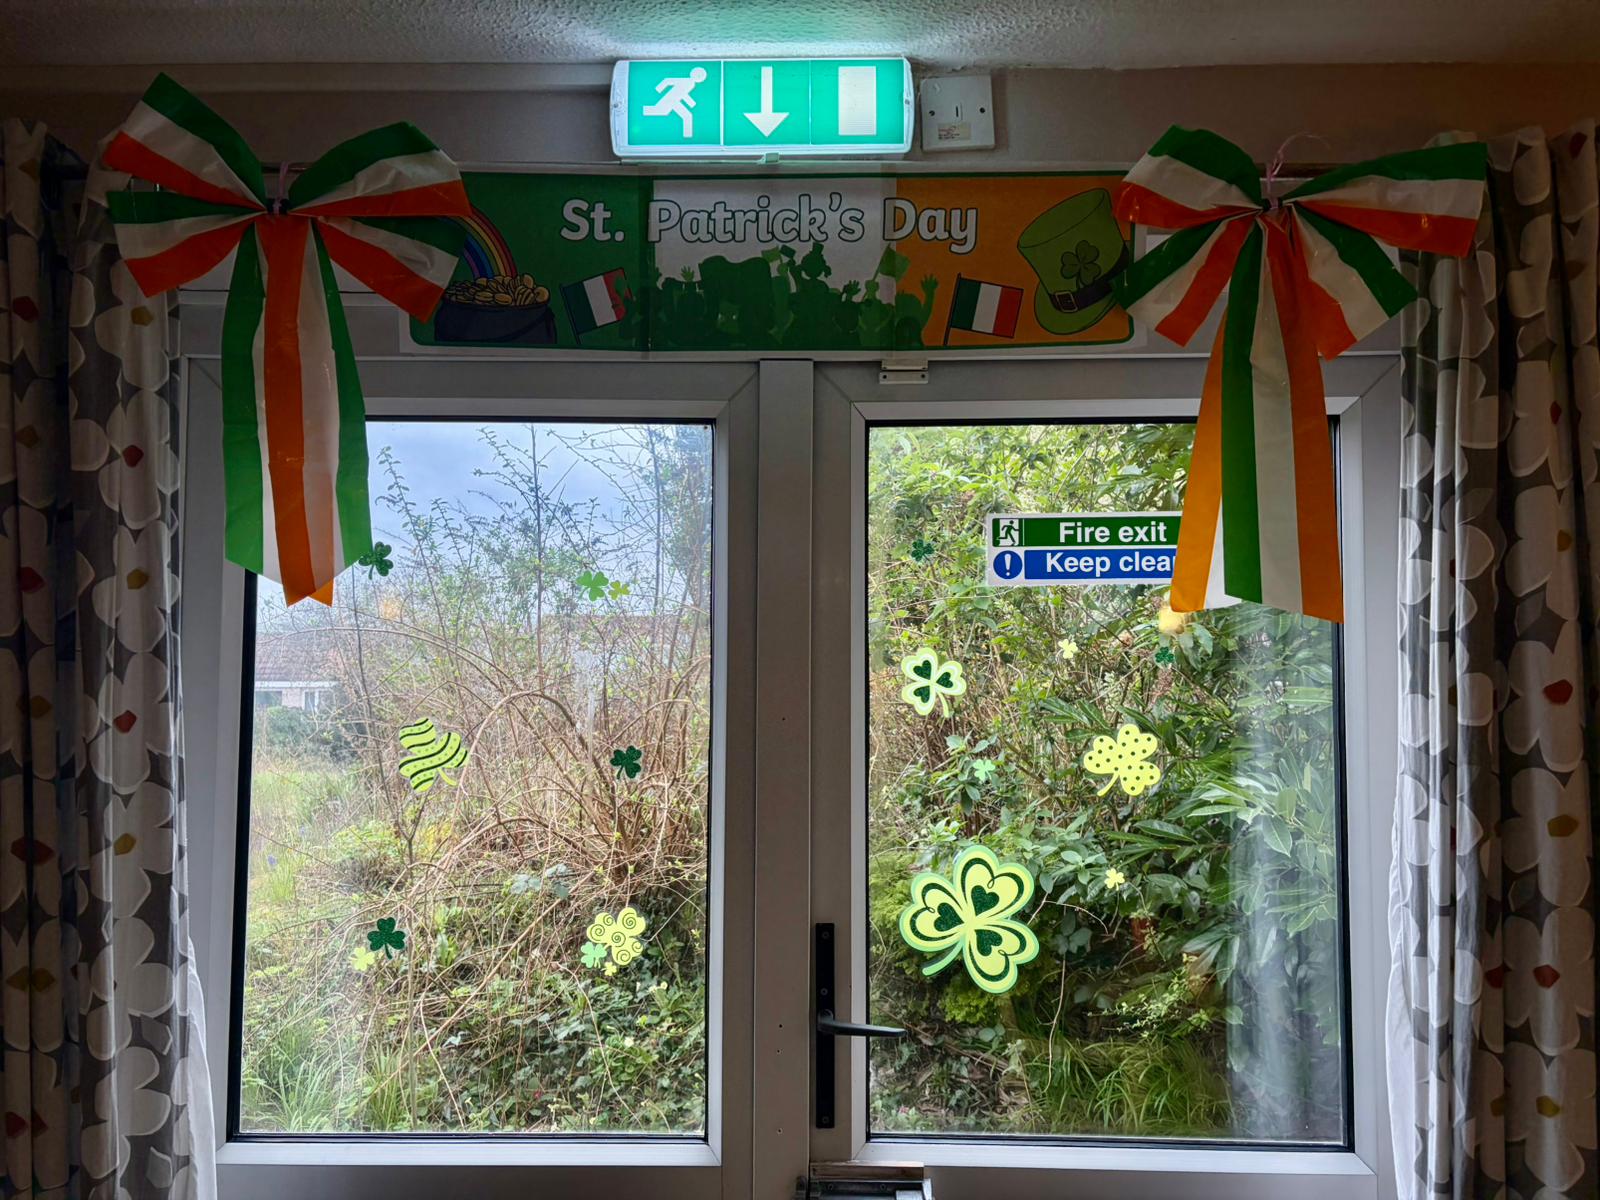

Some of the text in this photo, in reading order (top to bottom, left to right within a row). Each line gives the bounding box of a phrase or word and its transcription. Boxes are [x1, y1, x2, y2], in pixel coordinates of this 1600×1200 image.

[560, 192, 979, 255] St. Patrick's Day
[1059, 521, 1168, 543] Fire exit
[1046, 551, 1111, 578] Keep
